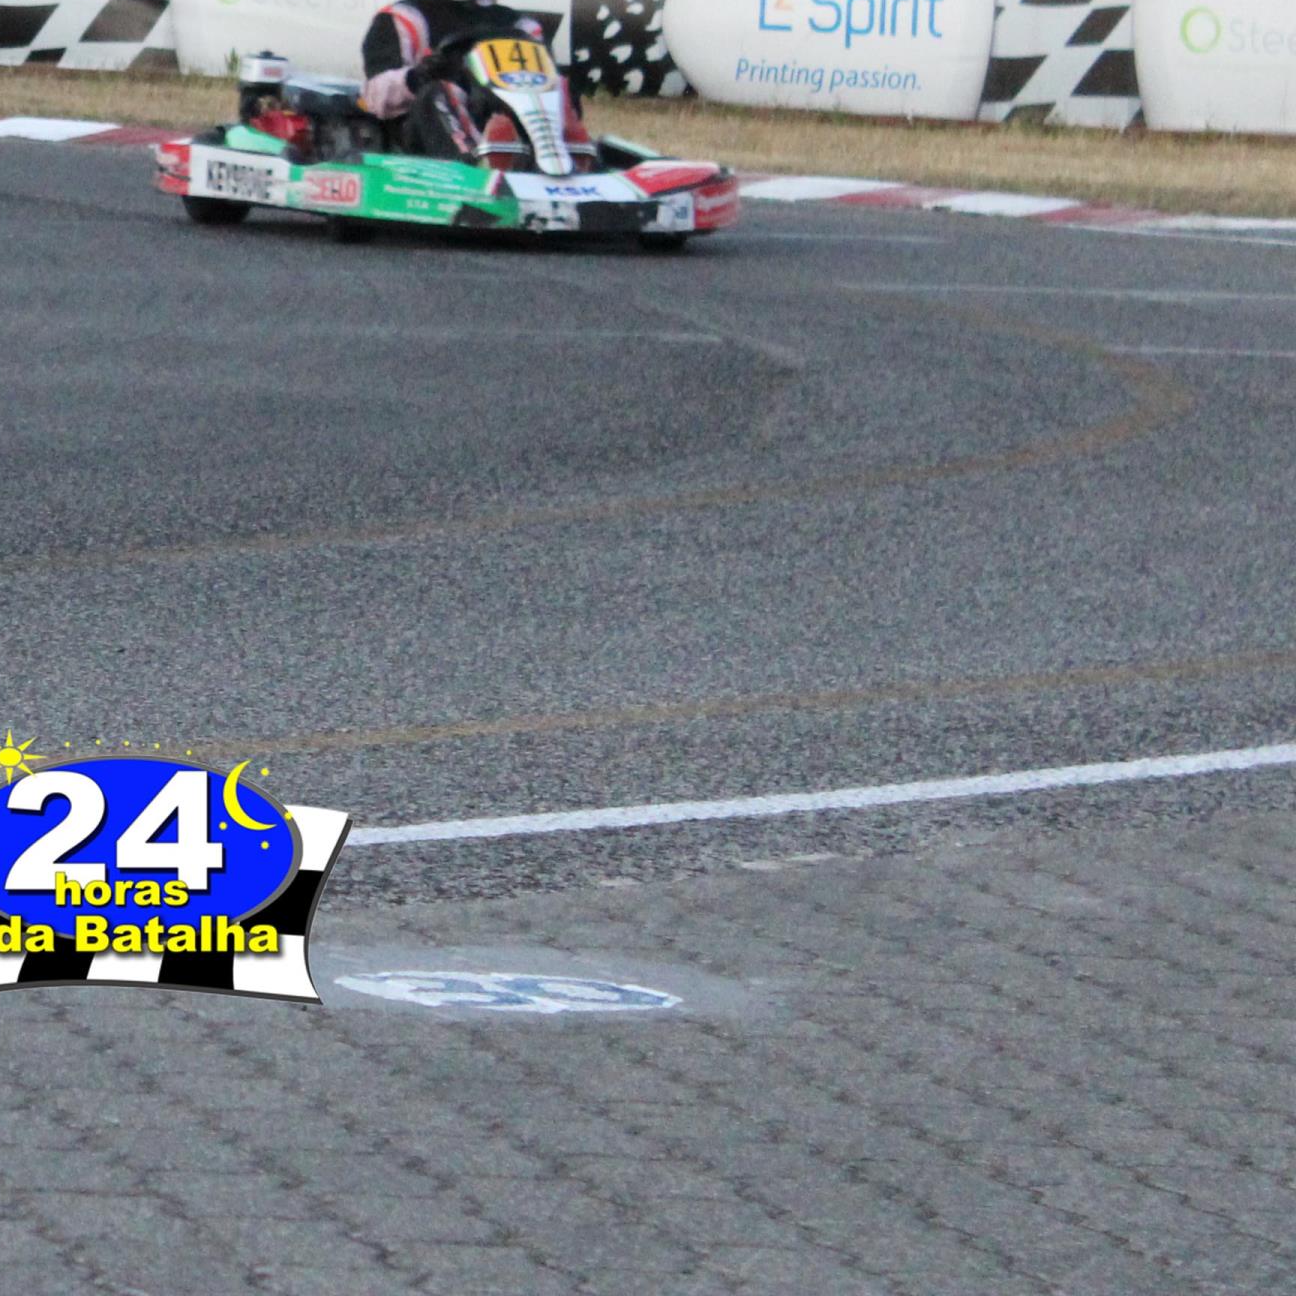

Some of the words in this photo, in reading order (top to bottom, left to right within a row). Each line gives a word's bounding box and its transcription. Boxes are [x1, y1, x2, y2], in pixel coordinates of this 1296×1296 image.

[488, 42, 545, 73] 141
[734, 57, 825, 93] Printing
[828, 64, 922, 93] passion.
[544, 185, 601, 197] KSK
